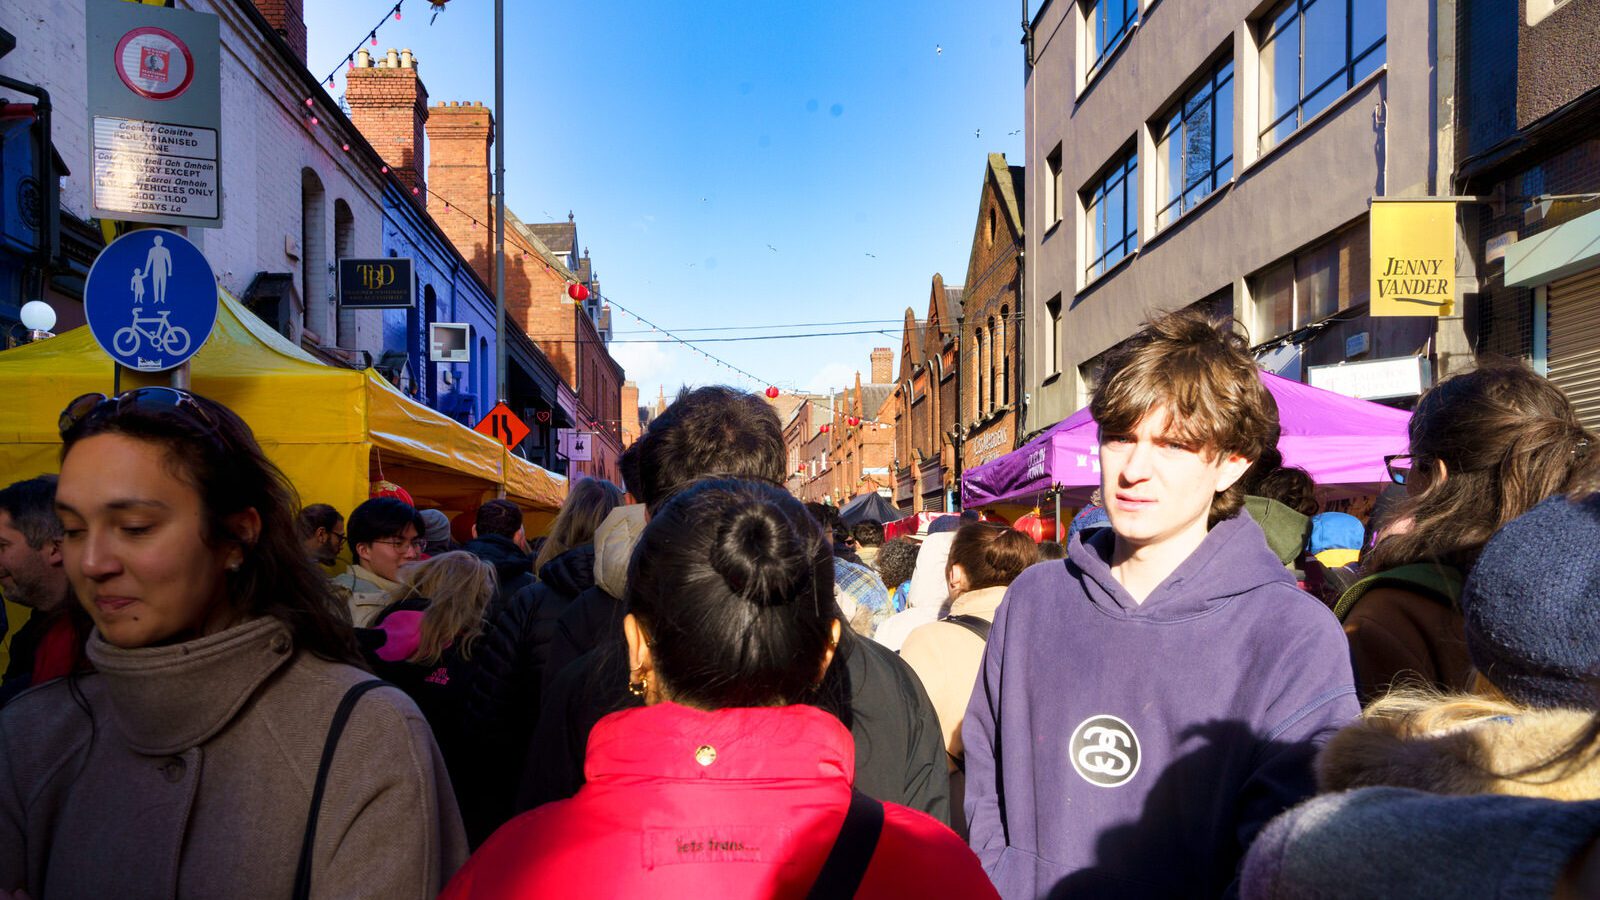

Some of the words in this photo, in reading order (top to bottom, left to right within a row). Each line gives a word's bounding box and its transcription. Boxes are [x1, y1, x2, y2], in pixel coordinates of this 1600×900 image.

[157, 126, 194, 137] Coisithe
[143, 142, 169, 153] ZONE
[164, 167, 201, 178] EXCEPT
[139, 182, 185, 194] VEHICLES
[188, 187, 214, 197] ONLY
[142, 202, 167, 211] DAYS
[1383, 257, 1443, 276] JENNY
[356, 264, 395, 290] TBD
[1377, 279, 1448, 298] VANDER
